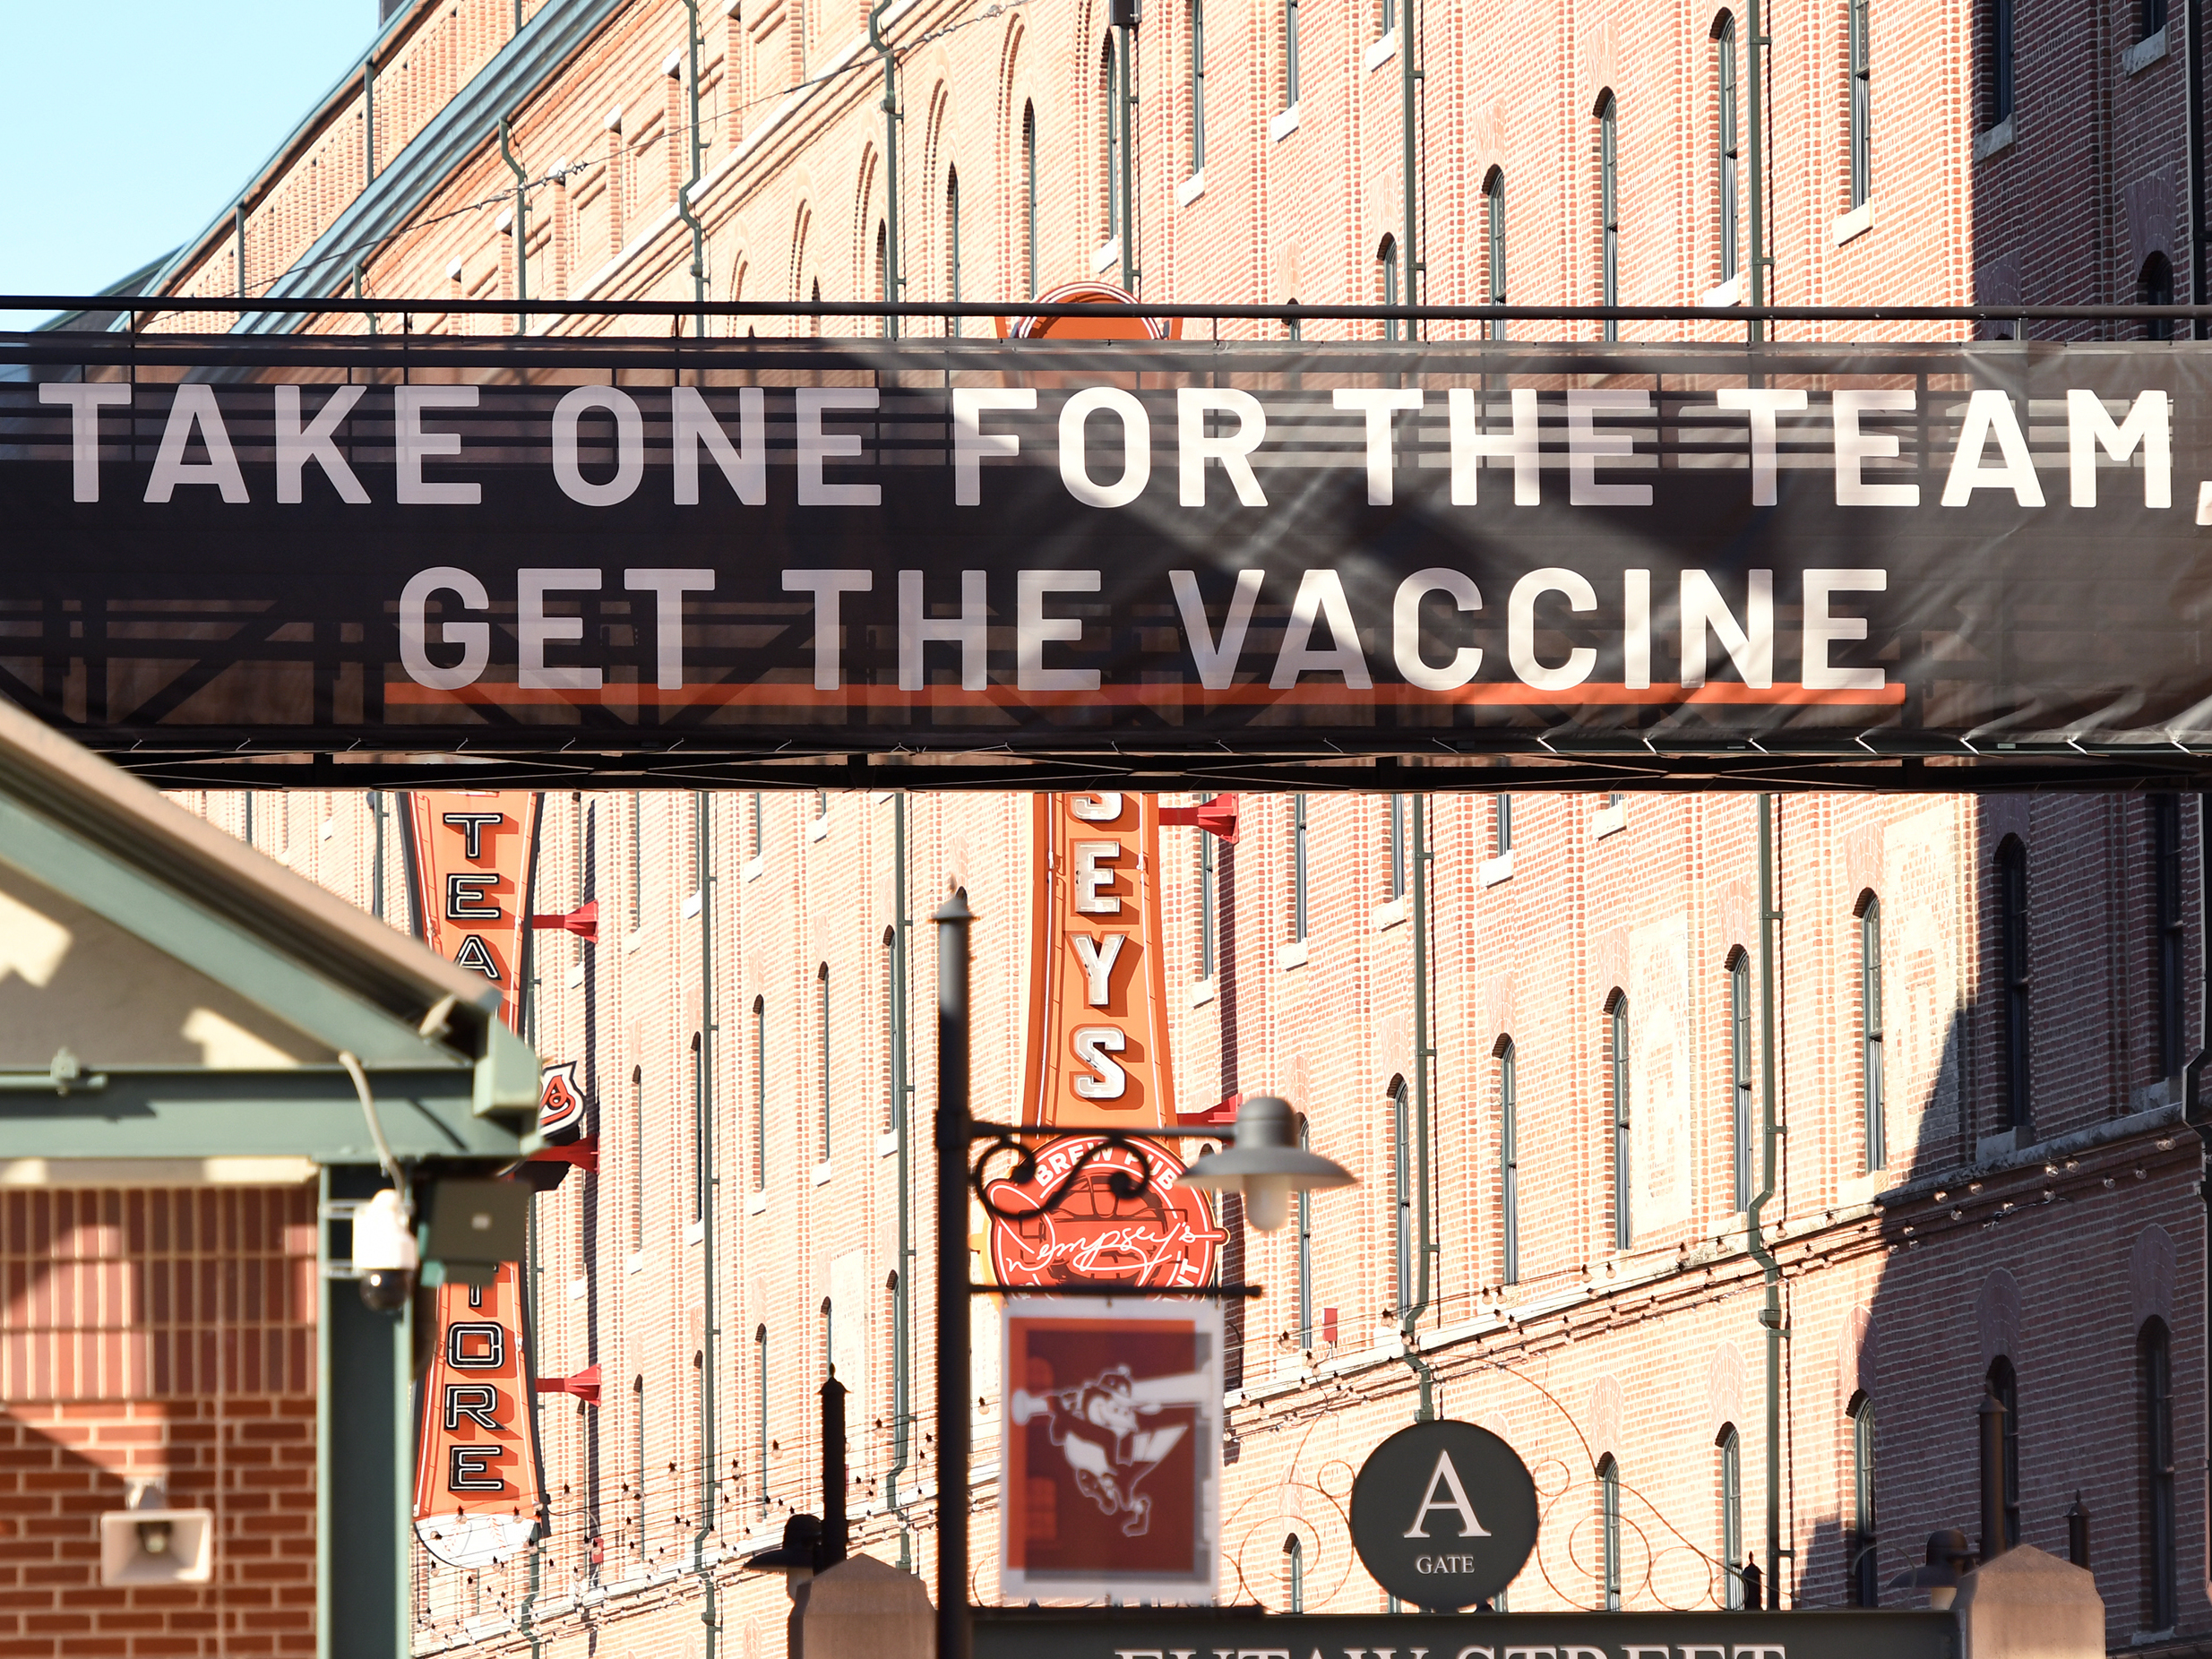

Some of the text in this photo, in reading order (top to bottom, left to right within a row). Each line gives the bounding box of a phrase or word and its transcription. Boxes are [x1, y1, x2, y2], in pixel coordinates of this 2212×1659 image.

[39, 383, 483, 505] TAKE
[551, 385, 882, 507] ONE
[952, 386, 1269, 508] FOR
[1332, 388, 1653, 507] THE
[400, 566, 1888, 692] GET THE VACCINE
[1035, 1141, 1114, 1187] BREW
[990, 1184, 1223, 1287] Dempsey's
[1403, 1448, 1492, 1538] A
[1416, 1555, 1476, 1575] GATE
